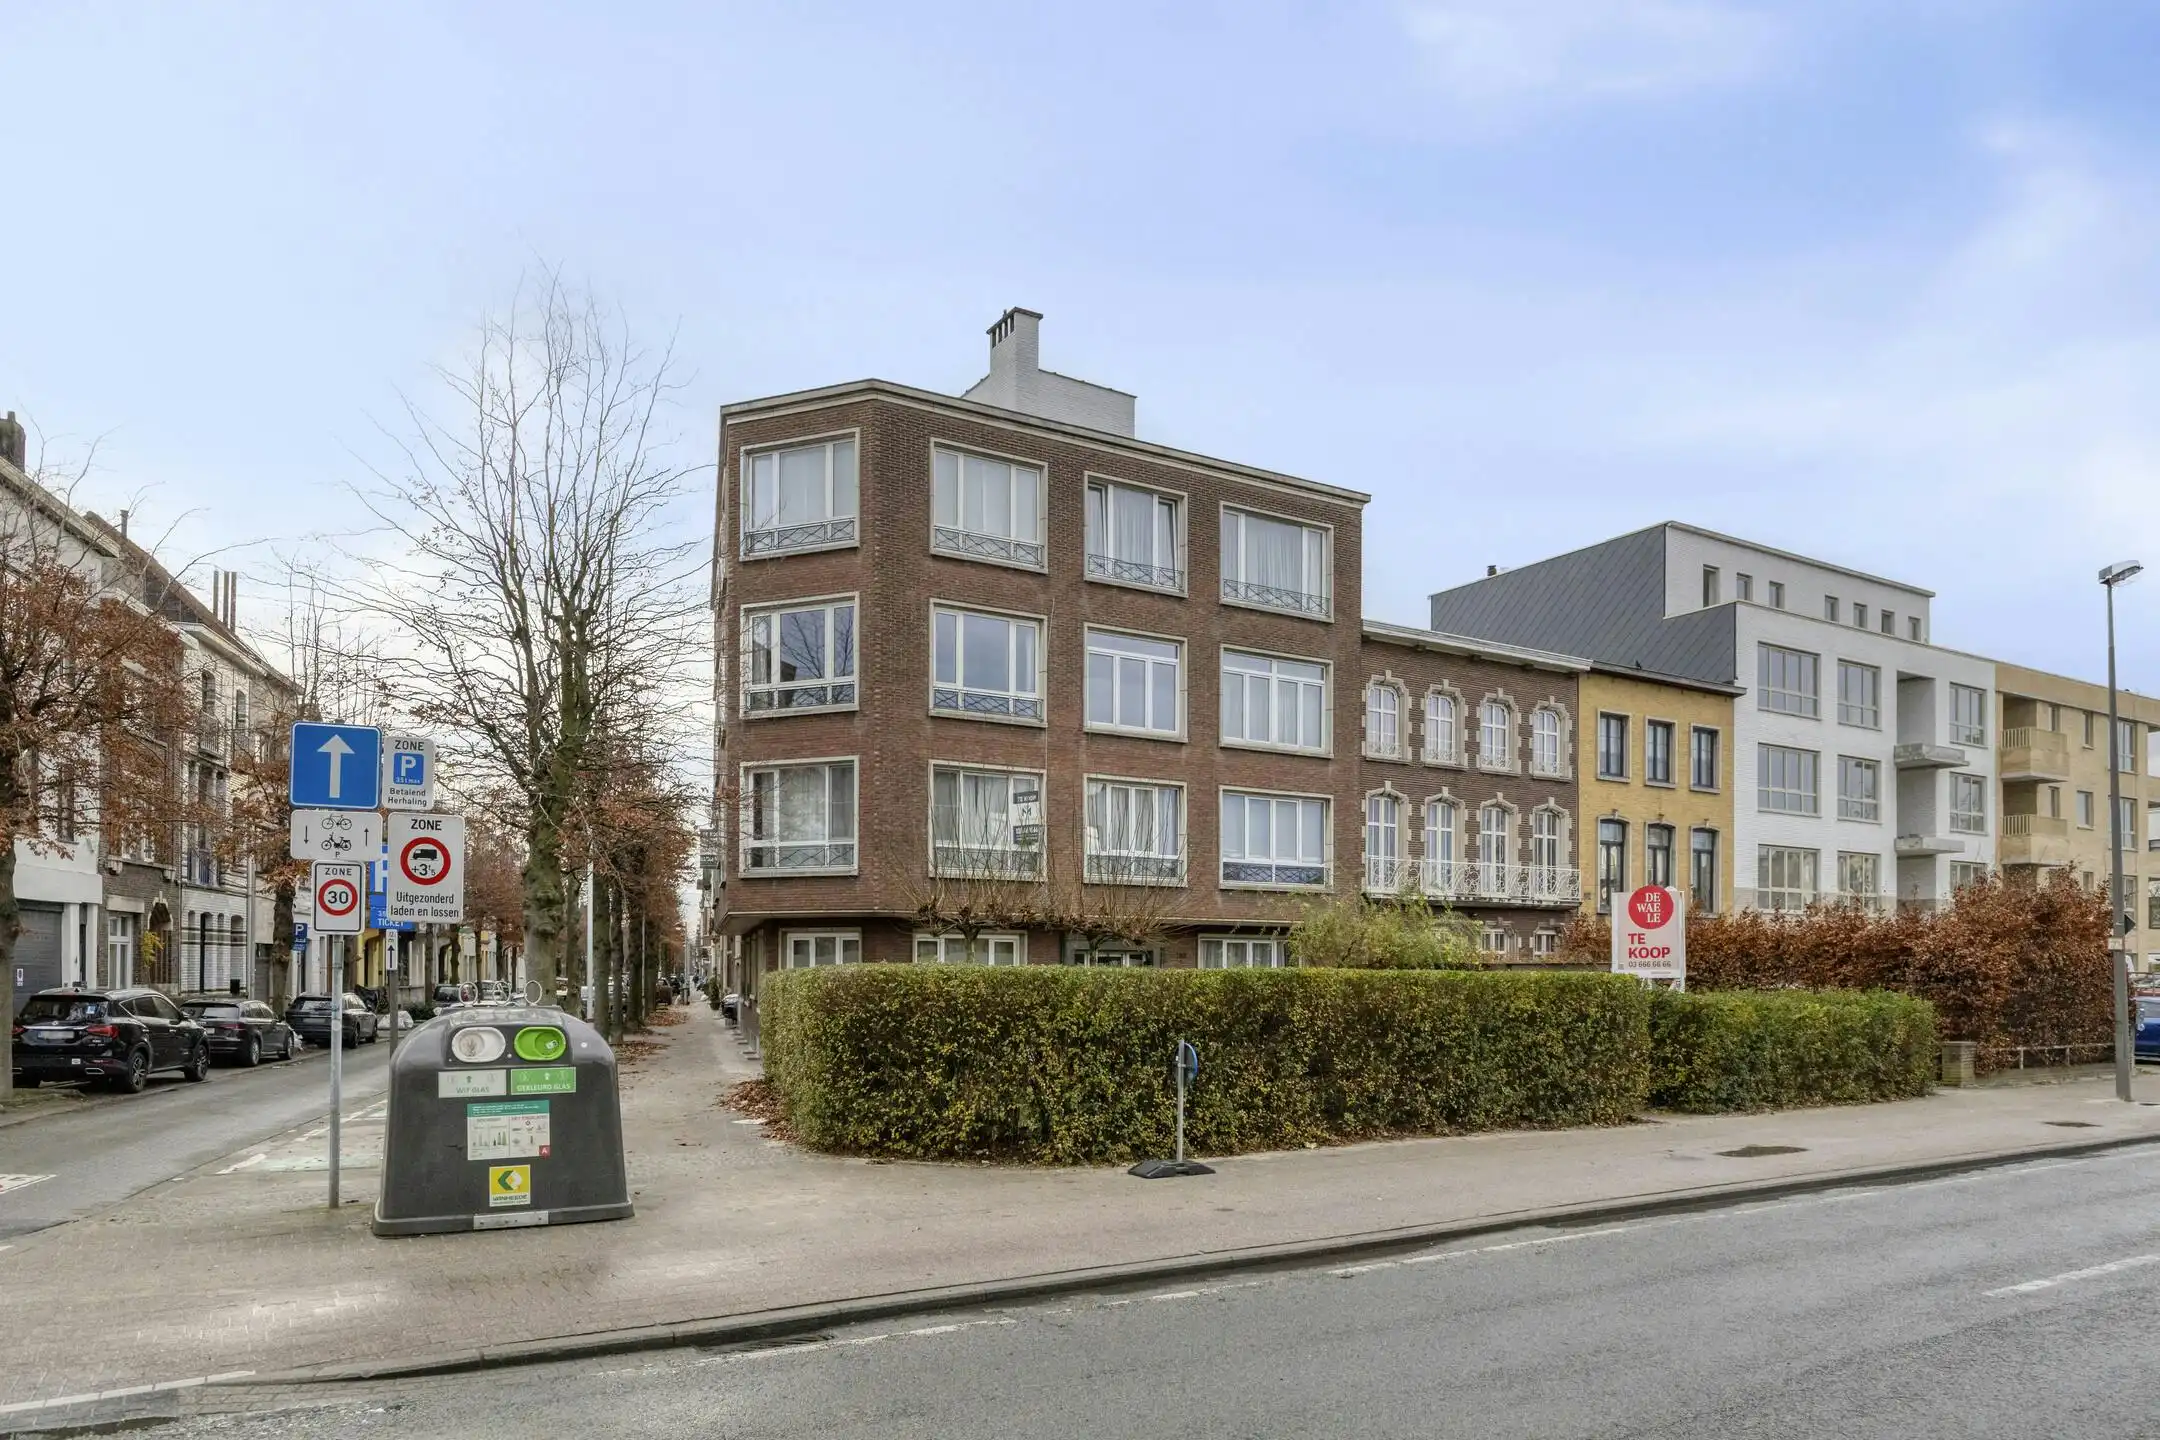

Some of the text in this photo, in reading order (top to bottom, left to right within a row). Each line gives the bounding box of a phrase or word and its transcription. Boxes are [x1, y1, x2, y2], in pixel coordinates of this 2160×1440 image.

[395, 740, 424, 751] ZONE
[401, 755, 416, 777] P
[390, 788, 426, 797] Betalend
[388, 796, 427, 807] Herhaling
[411, 819, 442, 831] ZONE
[325, 867, 352, 876] ZONE
[327, 890, 349, 905] 30
[396, 891, 455, 906] Uitgezonderd
[1645, 893, 1661, 903] DE
[390, 904, 414, 916] laden
[417, 907, 428, 917] en
[431, 906, 459, 918] lossen
[1637, 902, 1661, 913] WAE
[1647, 913, 1661, 923] LE
[295, 923, 304, 936] P
[1628, 933, 1646, 945] TE
[1628, 947, 1671, 959] KOOP
